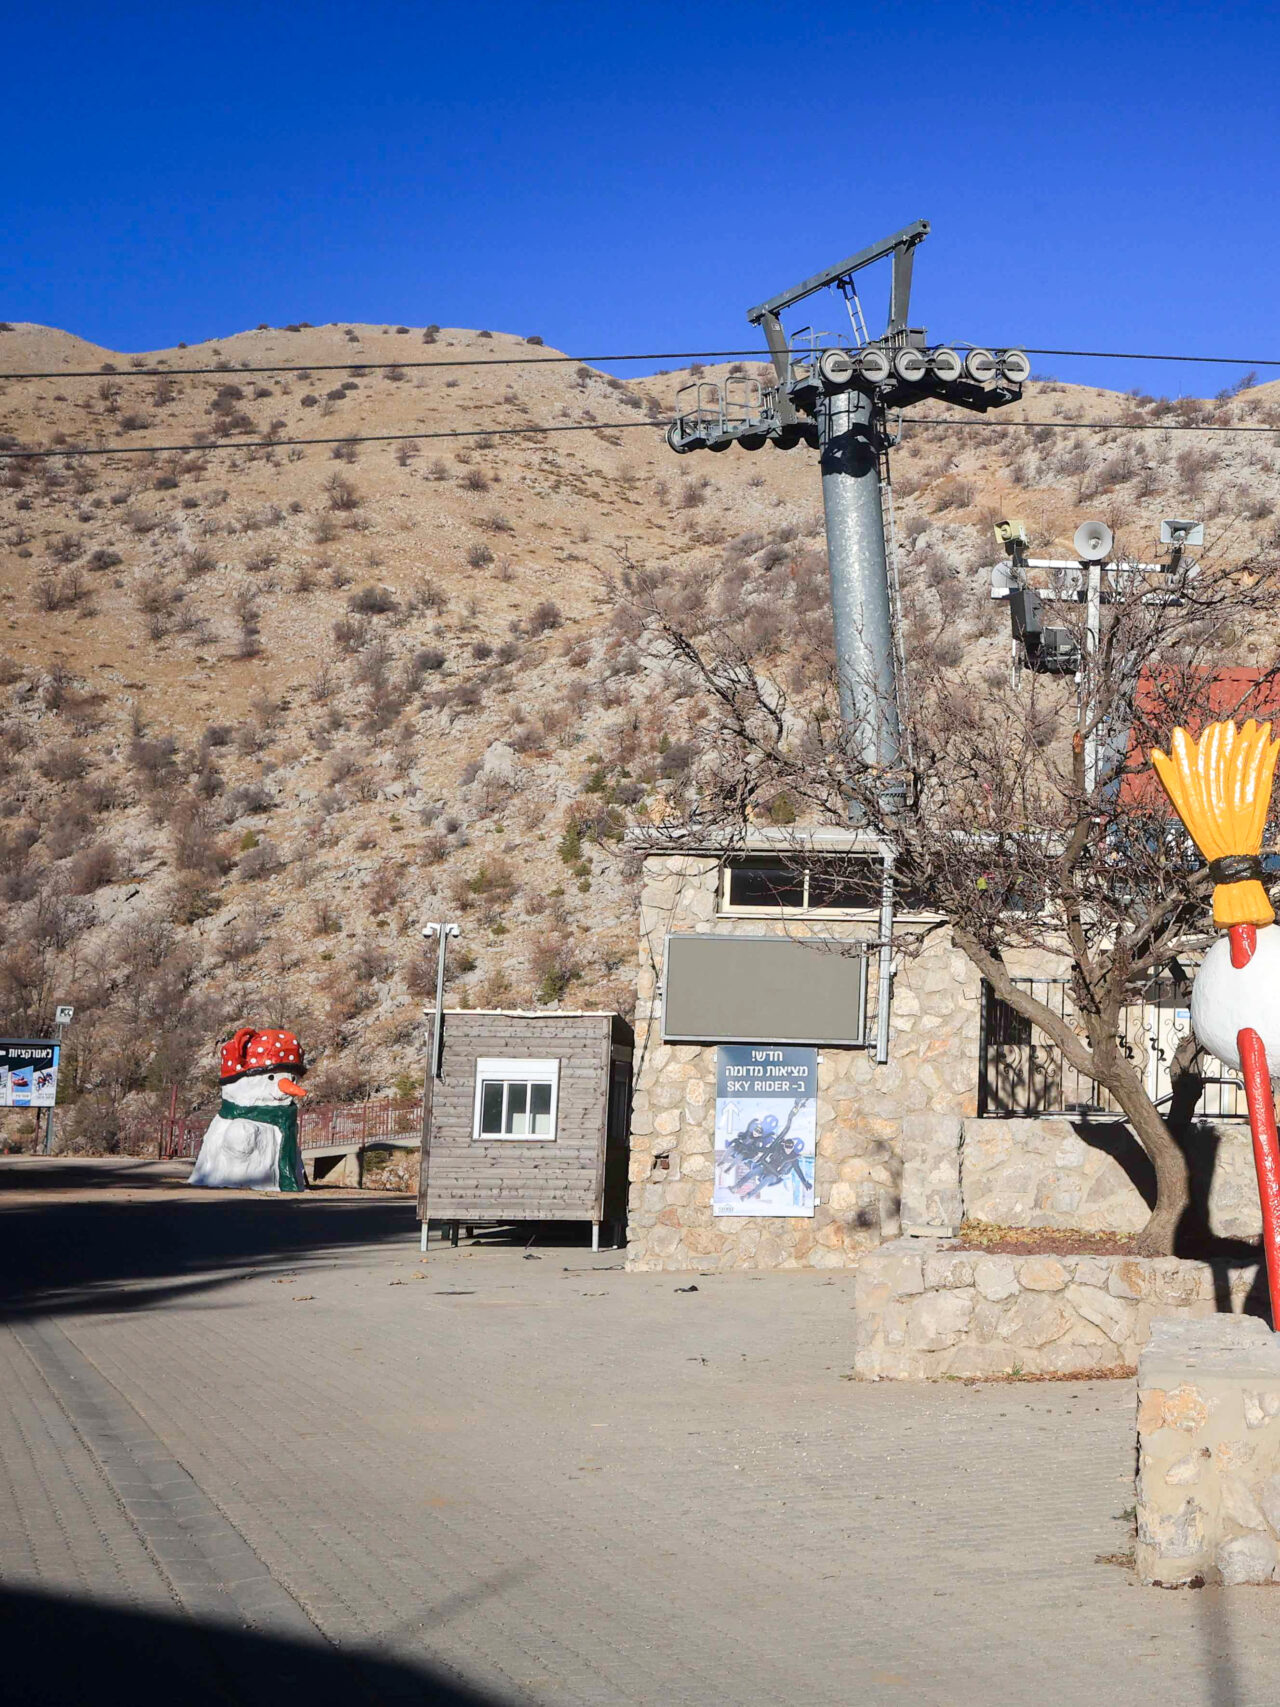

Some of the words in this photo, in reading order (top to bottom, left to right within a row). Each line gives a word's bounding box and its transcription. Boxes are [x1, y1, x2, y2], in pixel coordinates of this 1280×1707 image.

[8, 1048, 52, 1059] לאטרקציות
[752, 1050, 782, 1062] חדש!
[726, 1065, 763, 1077] מדומה
[766, 1065, 808, 1077] מציאות
[727, 1080, 751, 1092] SKY
[754, 1081, 790, 1092] RIDER
